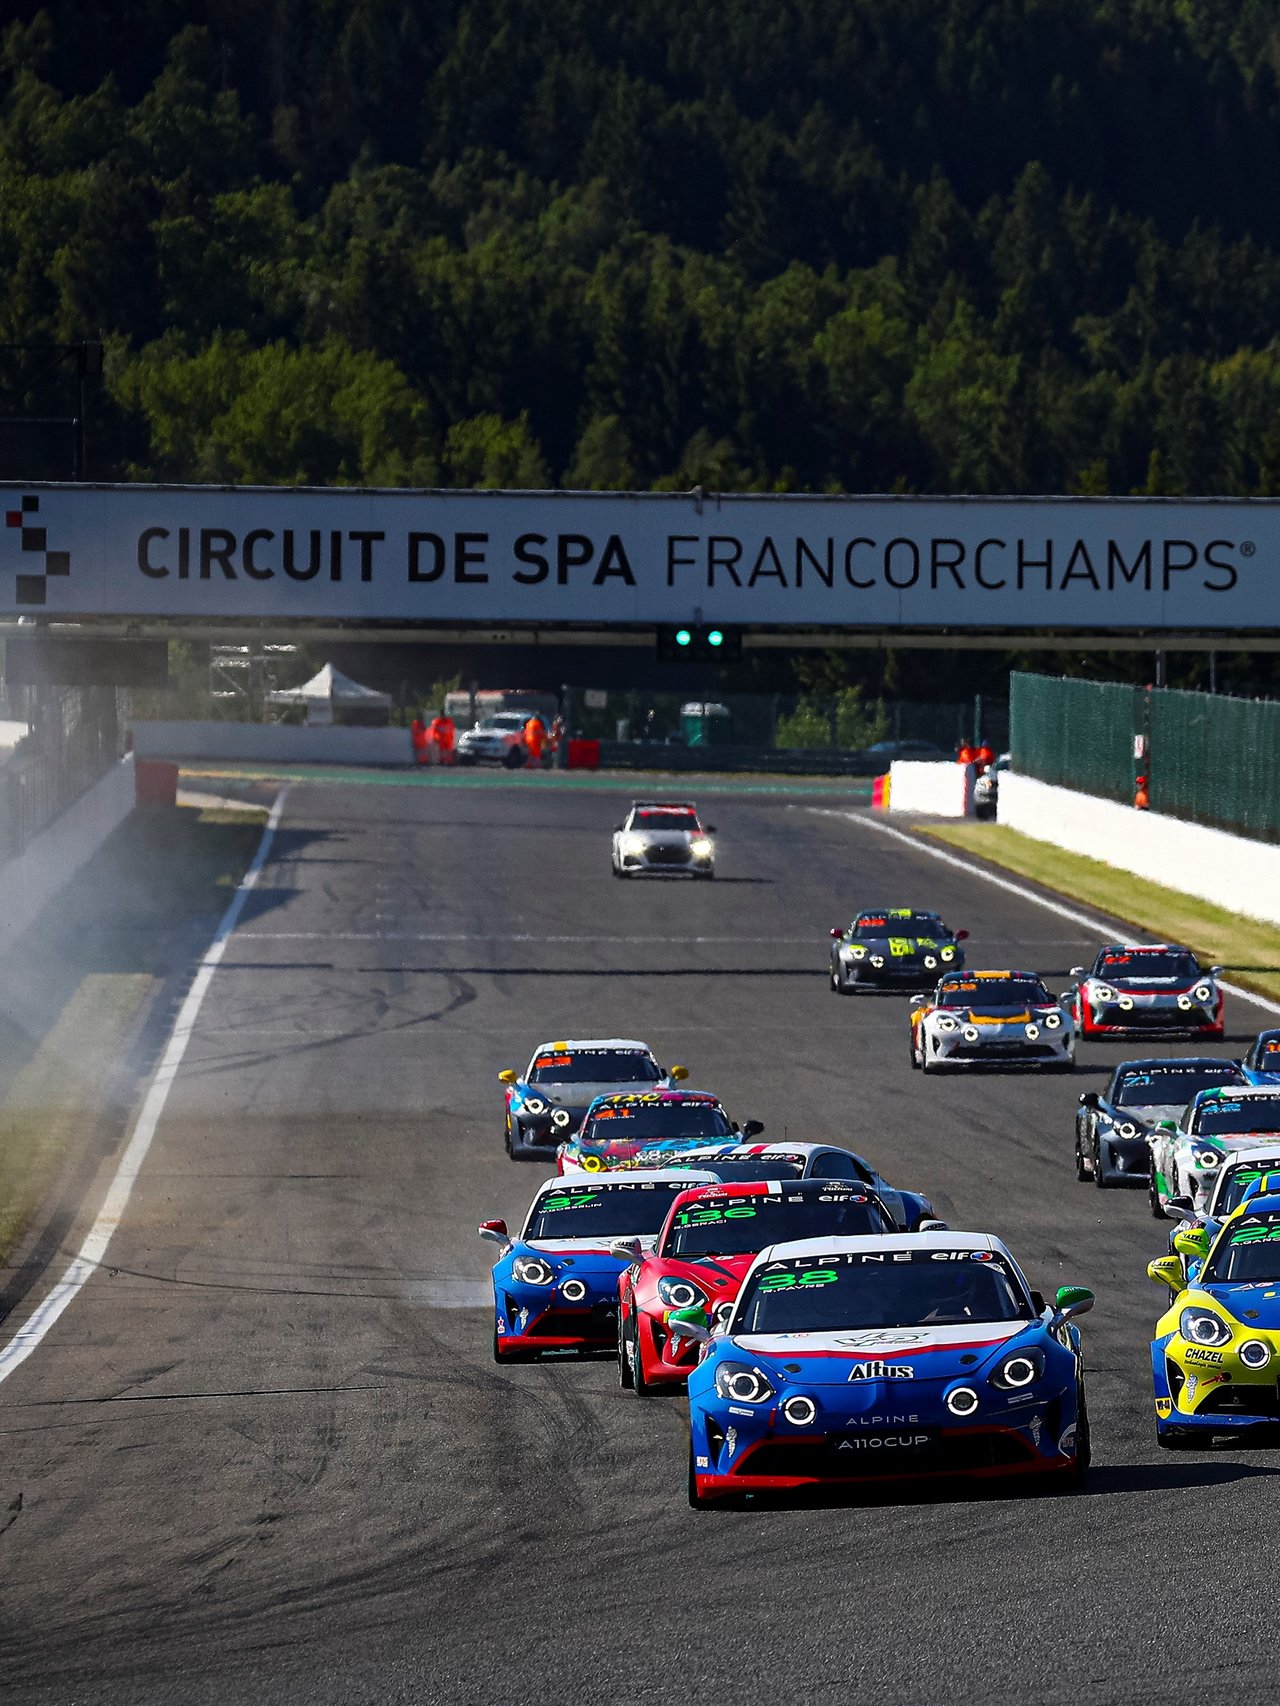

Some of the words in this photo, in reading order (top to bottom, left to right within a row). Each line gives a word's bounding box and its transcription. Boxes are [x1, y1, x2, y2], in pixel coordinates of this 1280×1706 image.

[137, 527, 385, 581] CIRCUIT
[407, 532, 489, 583] DE
[511, 533, 637, 585] SPA
[549, 1183, 656, 1196] ALPINE
[543, 1194, 598, 1210] 37
[686, 1196, 804, 1211] ALPINE
[676, 1207, 757, 1225] 136
[764, 1253, 913, 1272] ALPINE
[931, 1251, 970, 1261] elf
[758, 1270, 838, 1291] 38
[1185, 1348, 1224, 1363] CHAZEL
[848, 1360, 914, 1381] Altus
[846, 1414, 919, 1426] ALPINE
[838, 1436, 928, 1450] A110CUP
